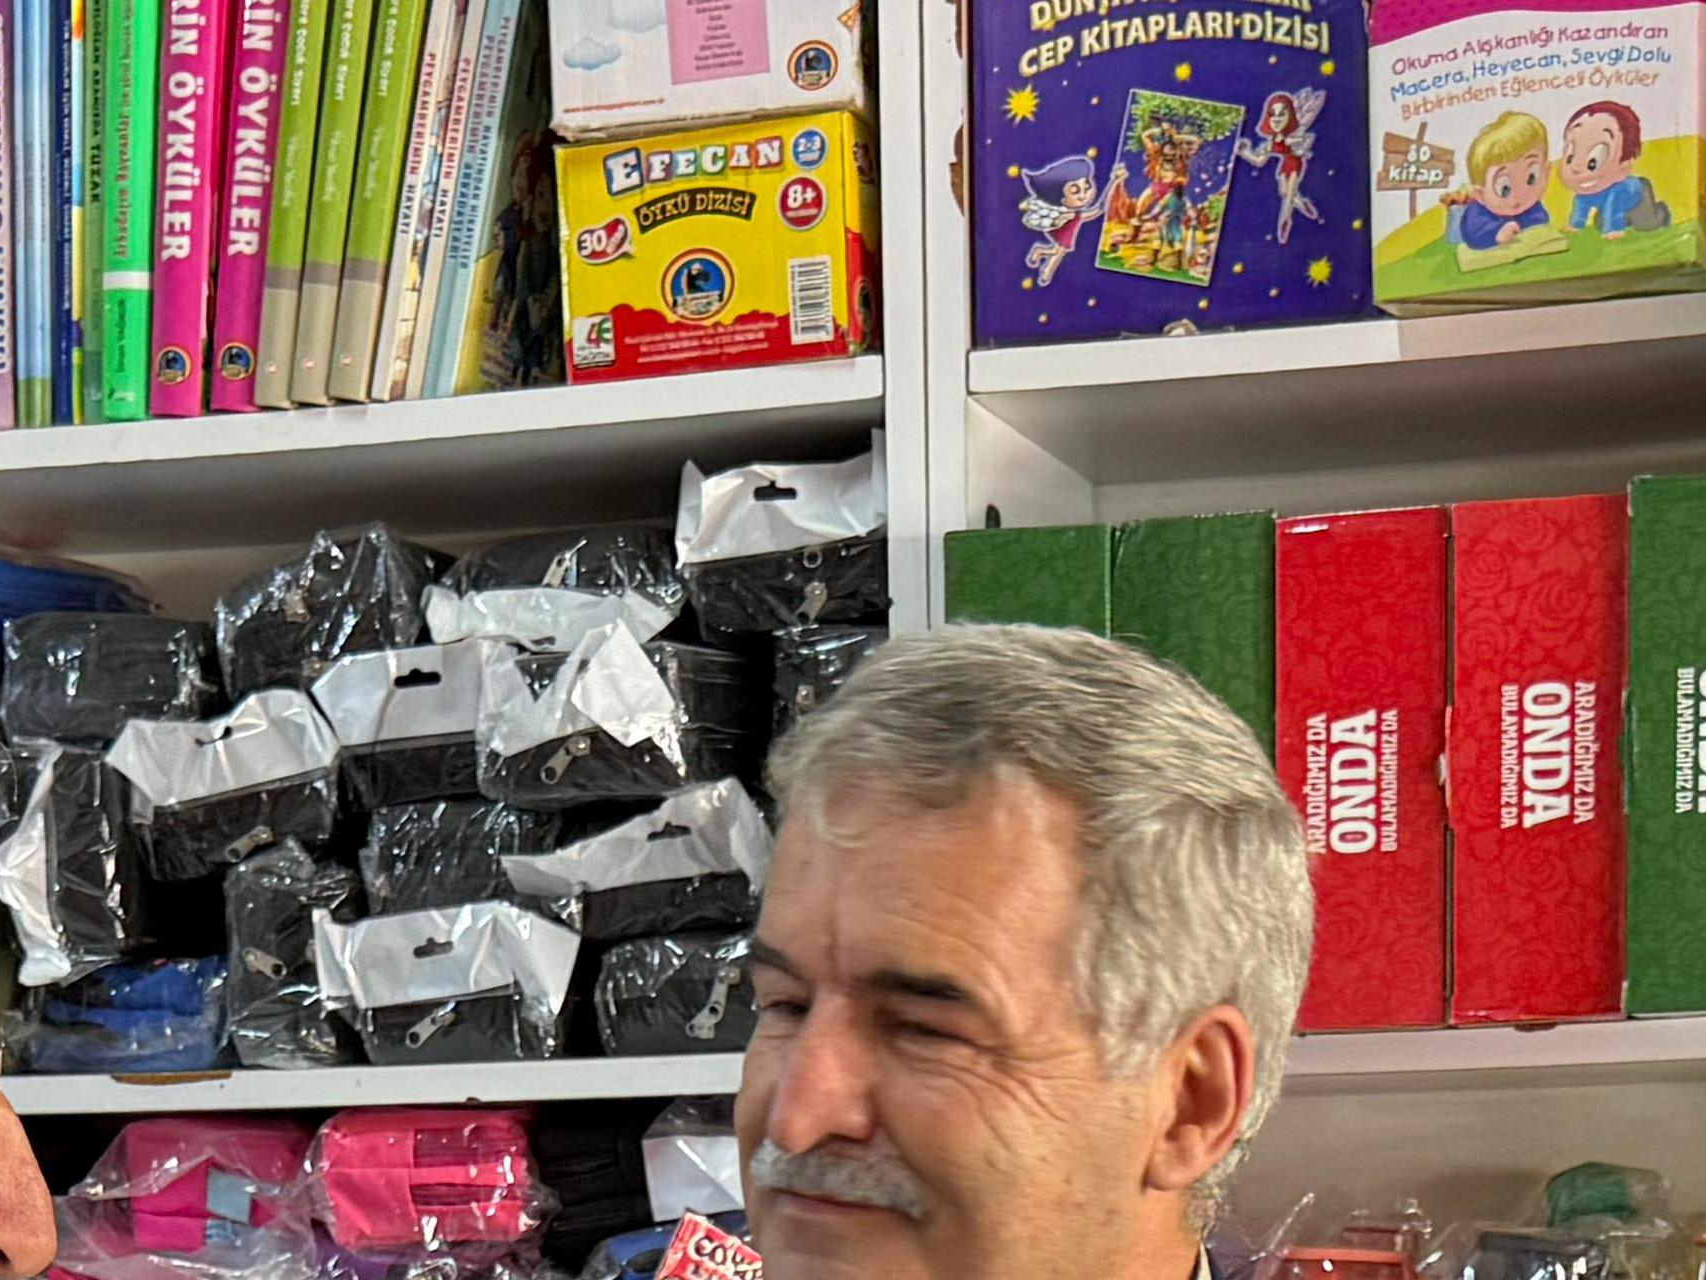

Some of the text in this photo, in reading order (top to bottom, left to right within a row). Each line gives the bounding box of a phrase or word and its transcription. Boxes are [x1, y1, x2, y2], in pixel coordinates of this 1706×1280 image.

[1019, 11, 1332, 78] CEP KİTAPLARI DİZİSİ
[1389, 44, 1673, 103] Macera, Heyecan, Sevgi Dolu
[1391, 21, 1670, 77] Okuma Alışkanlığı Kazandıran
[1400, 64, 1664, 122] Birbirinden Eğlenceli Öyküler
[160, 76, 206, 262] ÖYKÜLER
[227, 67, 277, 258] ÖYKÜLER
[639, 189, 753, 228] ÖYKÜ DİZİSİ
[1388, 162, 1444, 186] kitap
[579, 228, 608, 258] 30
[1306, 713, 1327, 854] ARADIĞIMIZ DA
[1329, 709, 1377, 855] ONDA
[1381, 709, 1398, 852] BULAMADIĞIMIZ DA
[1500, 684, 1519, 830] BULAMADIĞIMIZ DA
[1522, 681, 1571, 828] ONDA
[1574, 680, 1596, 825] ARADIĞIMIZ DA
[1675, 667, 1695, 815] BULAMADIĞIMIZ DA
